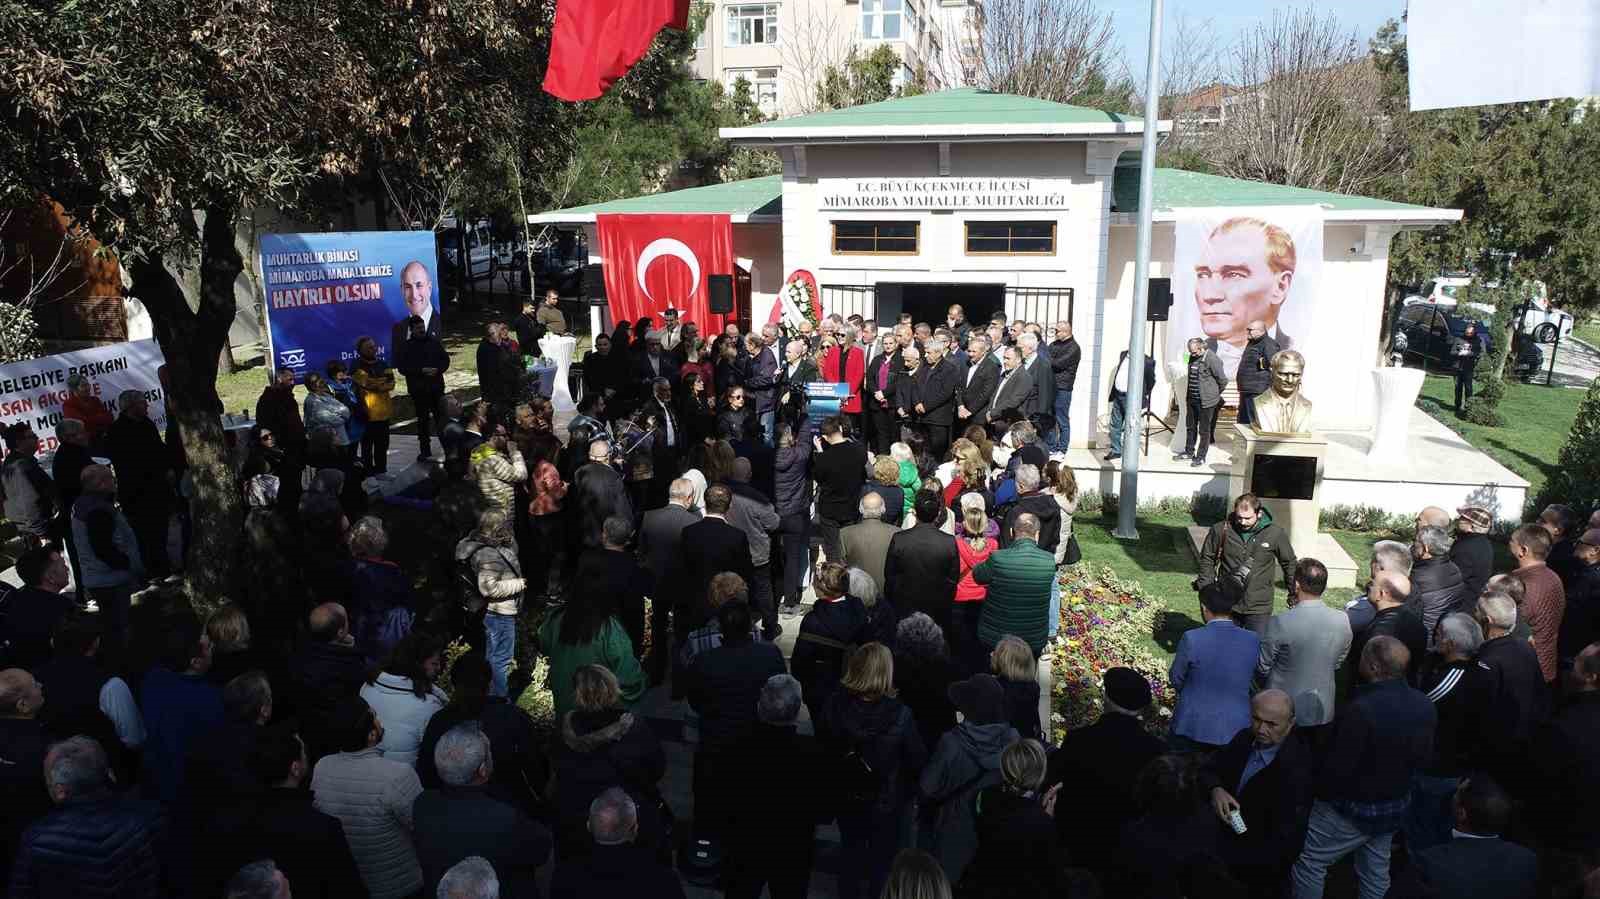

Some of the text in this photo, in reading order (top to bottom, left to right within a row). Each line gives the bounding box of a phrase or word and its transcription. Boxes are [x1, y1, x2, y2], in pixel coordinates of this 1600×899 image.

[880, 180, 984, 193] BÜYÜKÇEKMECE
[989, 179, 1030, 192] İLÇESİ
[823, 192, 1065, 207] MİMAROBA MAHALLE MUHTARLIĞI
[266, 249, 358, 266] MUHTARLIK BİNASI
[269, 263, 393, 284] MİMAROBA MAHALLEMİZE
[272, 283, 381, 308] HAYIRLI OLSUN
